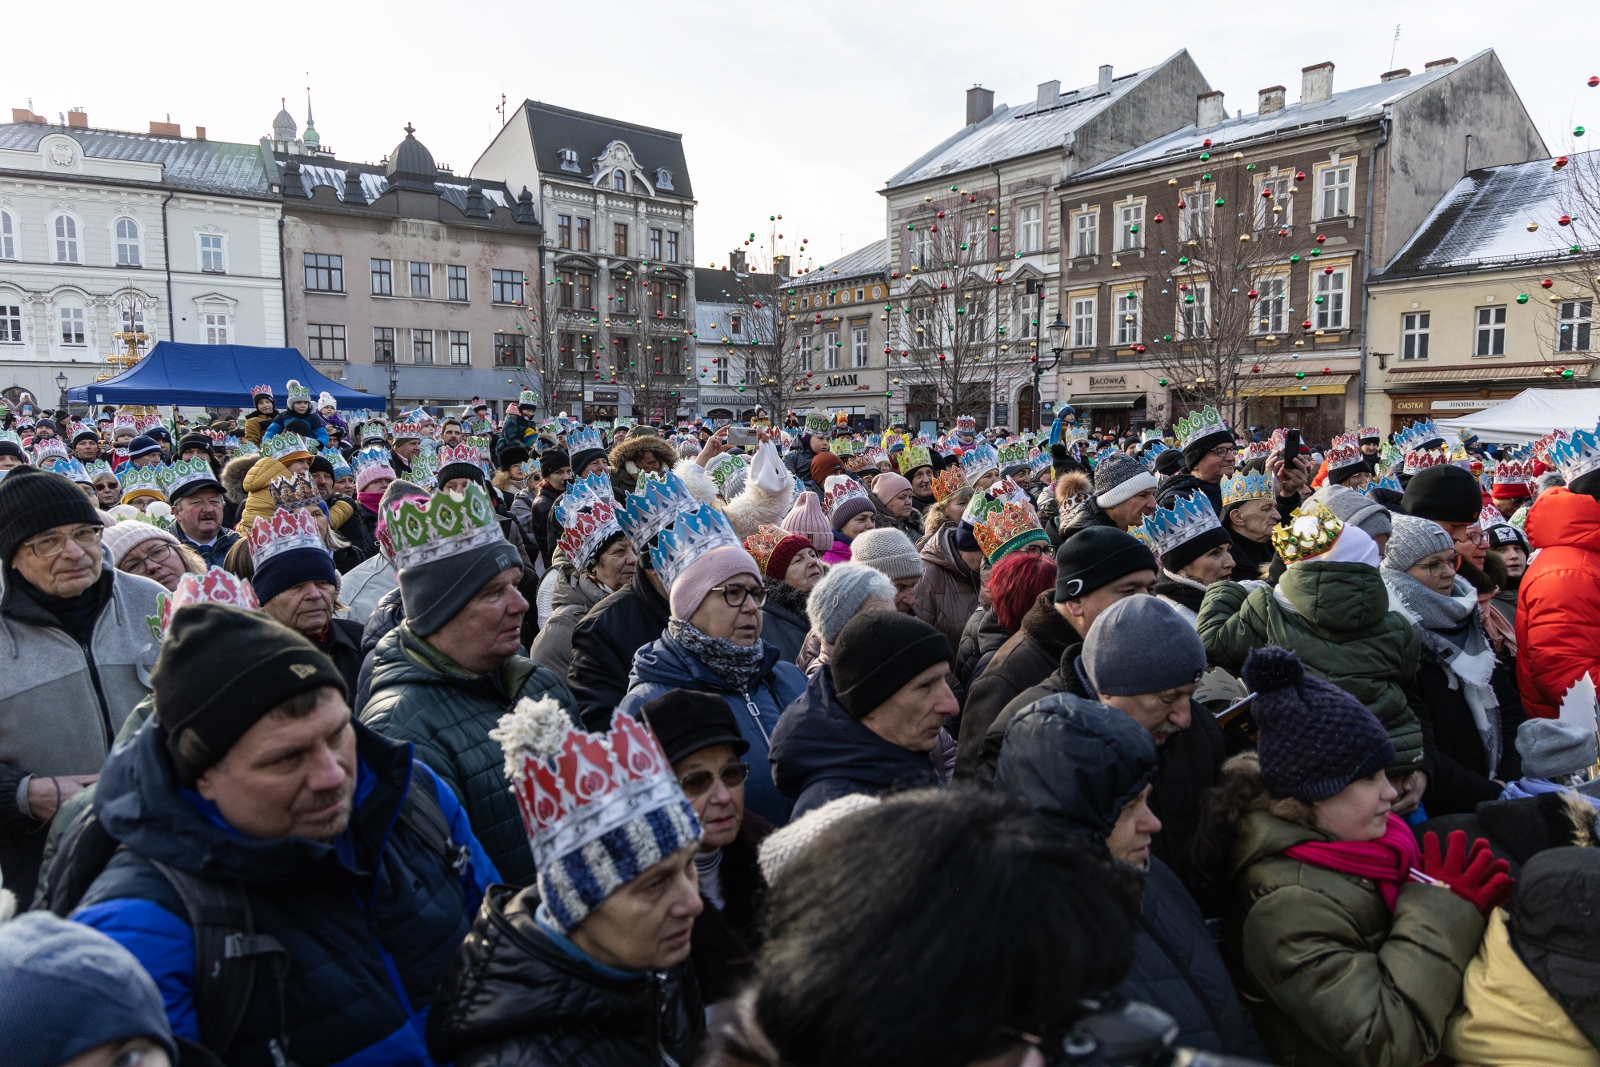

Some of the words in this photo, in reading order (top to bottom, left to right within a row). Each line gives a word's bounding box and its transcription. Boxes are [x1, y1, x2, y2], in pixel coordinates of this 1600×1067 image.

[826, 374, 858, 387] ADAM
[1089, 376, 1126, 386] BACÓWKA
[703, 396, 721, 404] JUBILER
